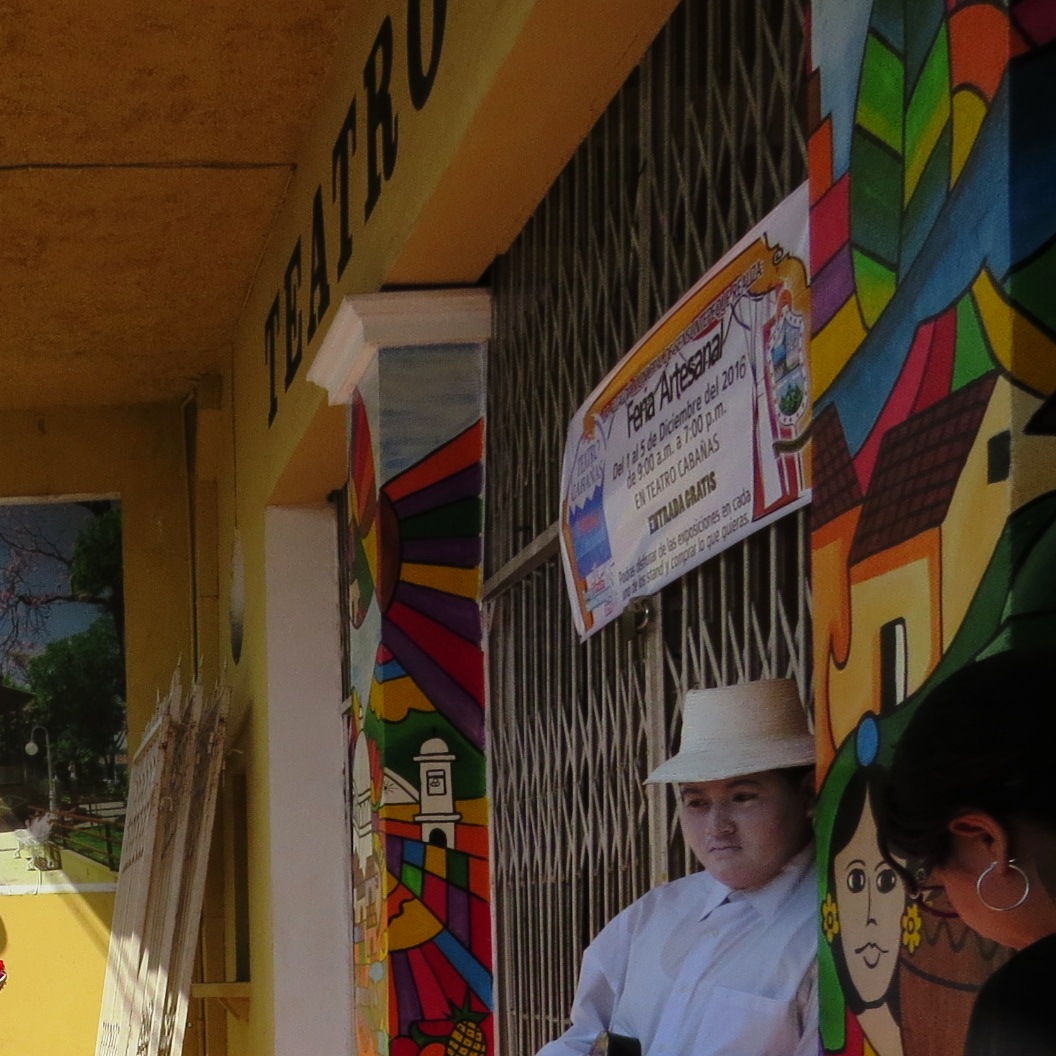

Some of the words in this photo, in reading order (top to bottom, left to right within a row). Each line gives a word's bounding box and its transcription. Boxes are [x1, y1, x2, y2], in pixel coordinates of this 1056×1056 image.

[613, 456, 624, 480] Del
[632, 443, 639, 464] al
[640, 439, 646, 457] 5
[647, 431, 657, 452] de
[659, 396, 702, 441] Diciembre
[704, 376, 719, 404] del
[722, 355, 747, 391] 2016
[626, 387, 656, 438] Feria
[659, 320, 724, 411] Artesanal
[627, 471, 636, 489] de
[637, 454, 655, 481] 9:00
[684, 414, 704, 443] 7:00
[706, 402, 727, 432] p.m.
[634, 492, 646, 510] EN
[646, 466, 677, 501] TEATRO
[678, 433, 720, 477] CABAÑAS
[648, 494, 684, 535] ENTRADA
[684, 471, 717, 509] GRATIS
[667, 536, 678, 552] las
[678, 510, 721, 547] exposiciones
[721, 502, 732, 518] en
[732, 488, 751, 512] cada
[671, 544, 698, 571] comprar
[698, 537, 705, 552] lo
[706, 530, 720, 551] que
